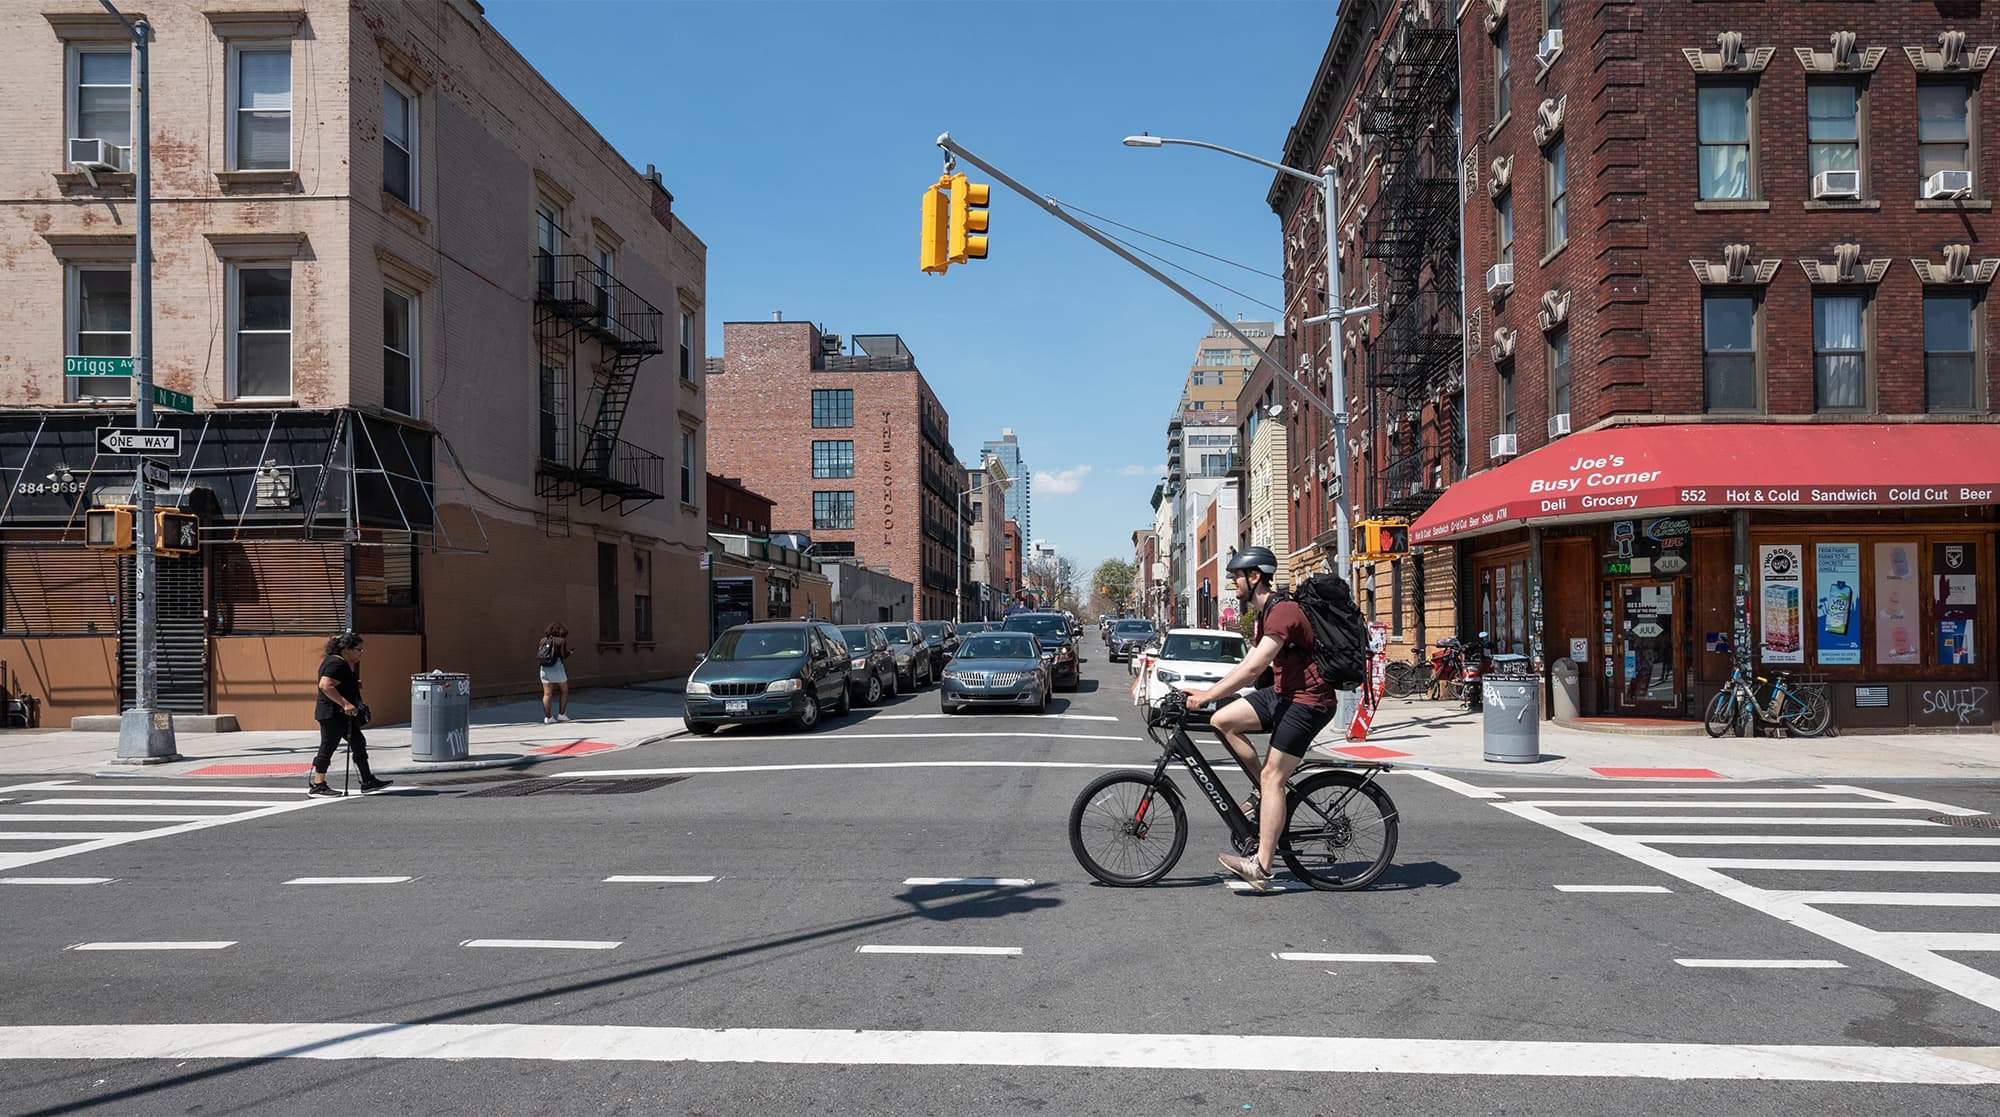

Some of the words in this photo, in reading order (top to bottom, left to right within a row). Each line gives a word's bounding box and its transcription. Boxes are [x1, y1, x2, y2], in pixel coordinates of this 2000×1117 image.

[67, 358, 114, 375] Driggs
[159, 389, 167, 405] N
[171, 392, 177, 407] 7
[882, 411, 892, 453] THE
[109, 436, 133, 448] ONE
[144, 437, 169, 448] WAY
[1569, 454, 1625, 471] Joe's
[18, 483, 86, 495] 384-9695
[1529, 478, 1582, 494] Busy
[1586, 470, 1662, 487] Corner
[883, 460, 894, 545] SCHOOL
[1541, 498, 1566, 512] Deli
[1581, 494, 1638, 508] Grocery
[1680, 490, 1706, 502] 552
[1726, 490, 1750, 502] Hot
[1754, 490, 1764, 502] &
[1767, 489, 1800, 502] Cold
[1811, 489, 1877, 502] Sandwich
[1888, 488, 1922, 501] Cold
[1924, 488, 1949, 501] Cut
[1960, 487, 1993, 500] Beer
[1469, 516, 1480, 527] Beer
[1481, 512, 1494, 523] Soda
[1496, 507, 1508, 520] ATM
[1764, 553, 1774, 569] TWO
[1773, 548, 1799, 569] ROBBERS
[1193, 766, 1229, 812] zoomo
